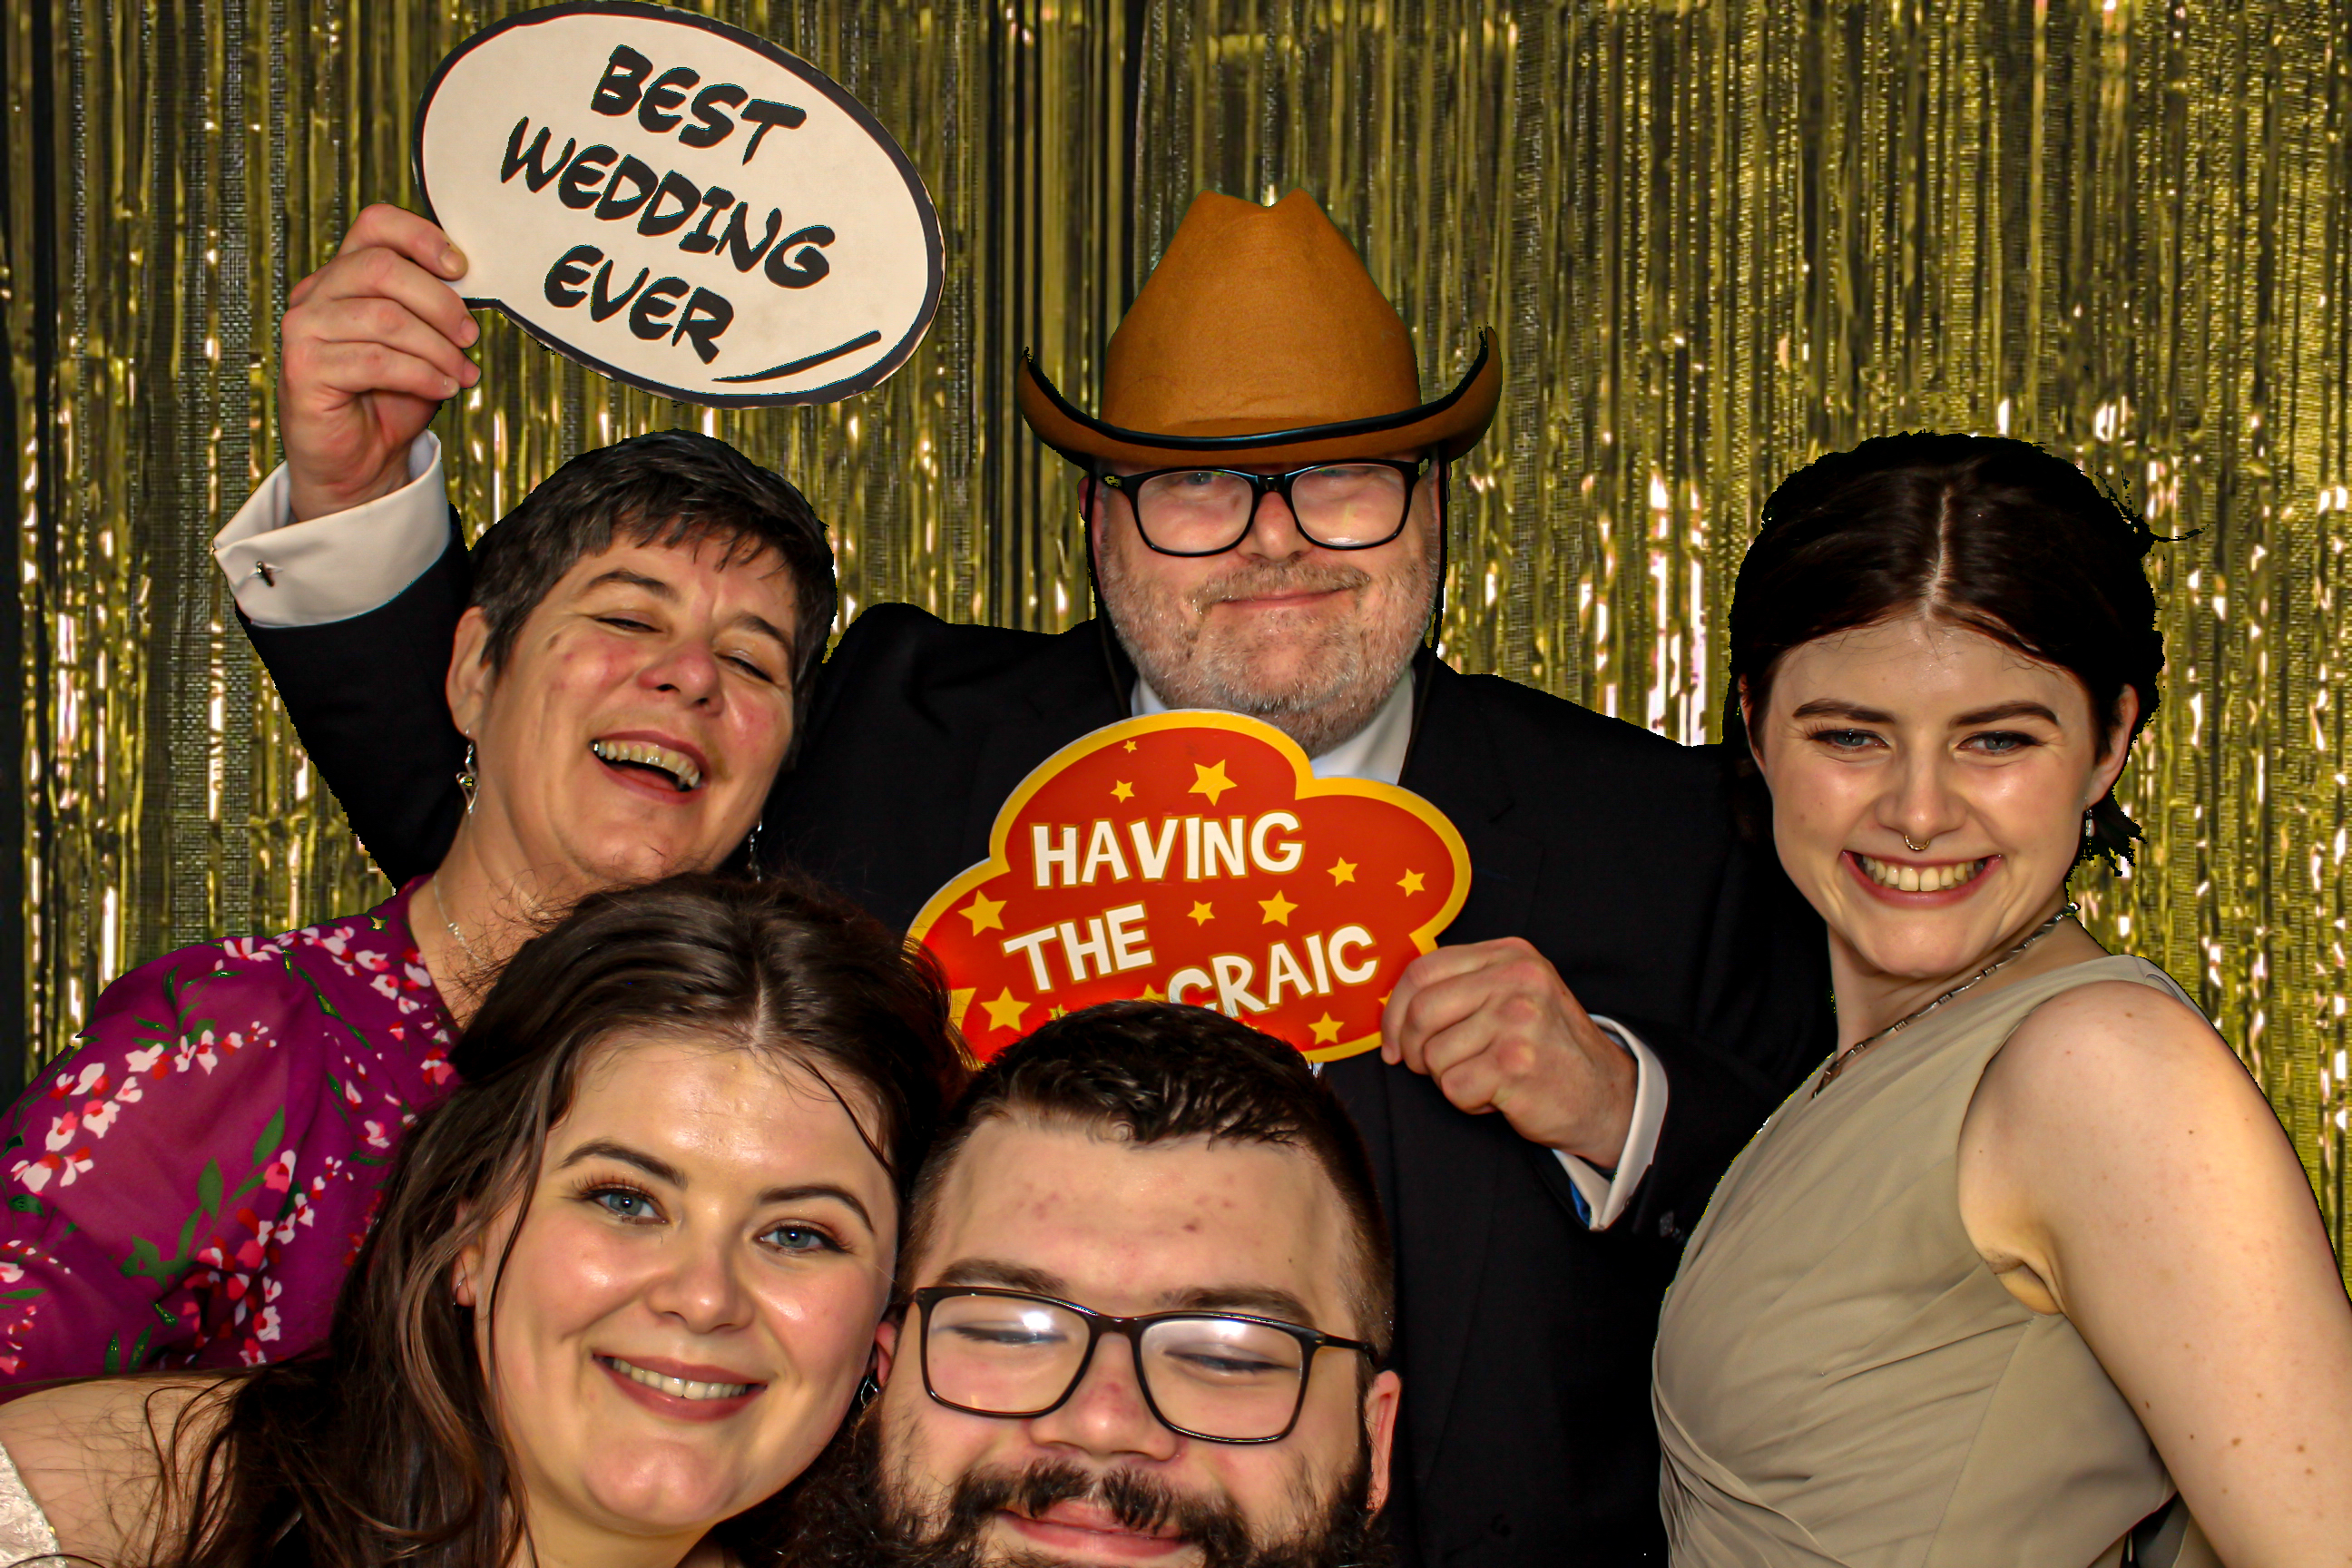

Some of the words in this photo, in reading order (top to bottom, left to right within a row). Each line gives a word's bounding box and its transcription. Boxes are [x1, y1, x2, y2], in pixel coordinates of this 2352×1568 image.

[591, 44, 807, 166] BEST
[500, 116, 836, 289] WEDDING
[544, 245, 734, 365] EVER
[1032, 810, 1304, 888] HAVING
[1003, 903, 1154, 992] THE
[1166, 925, 1378, 1017] CRAIC
